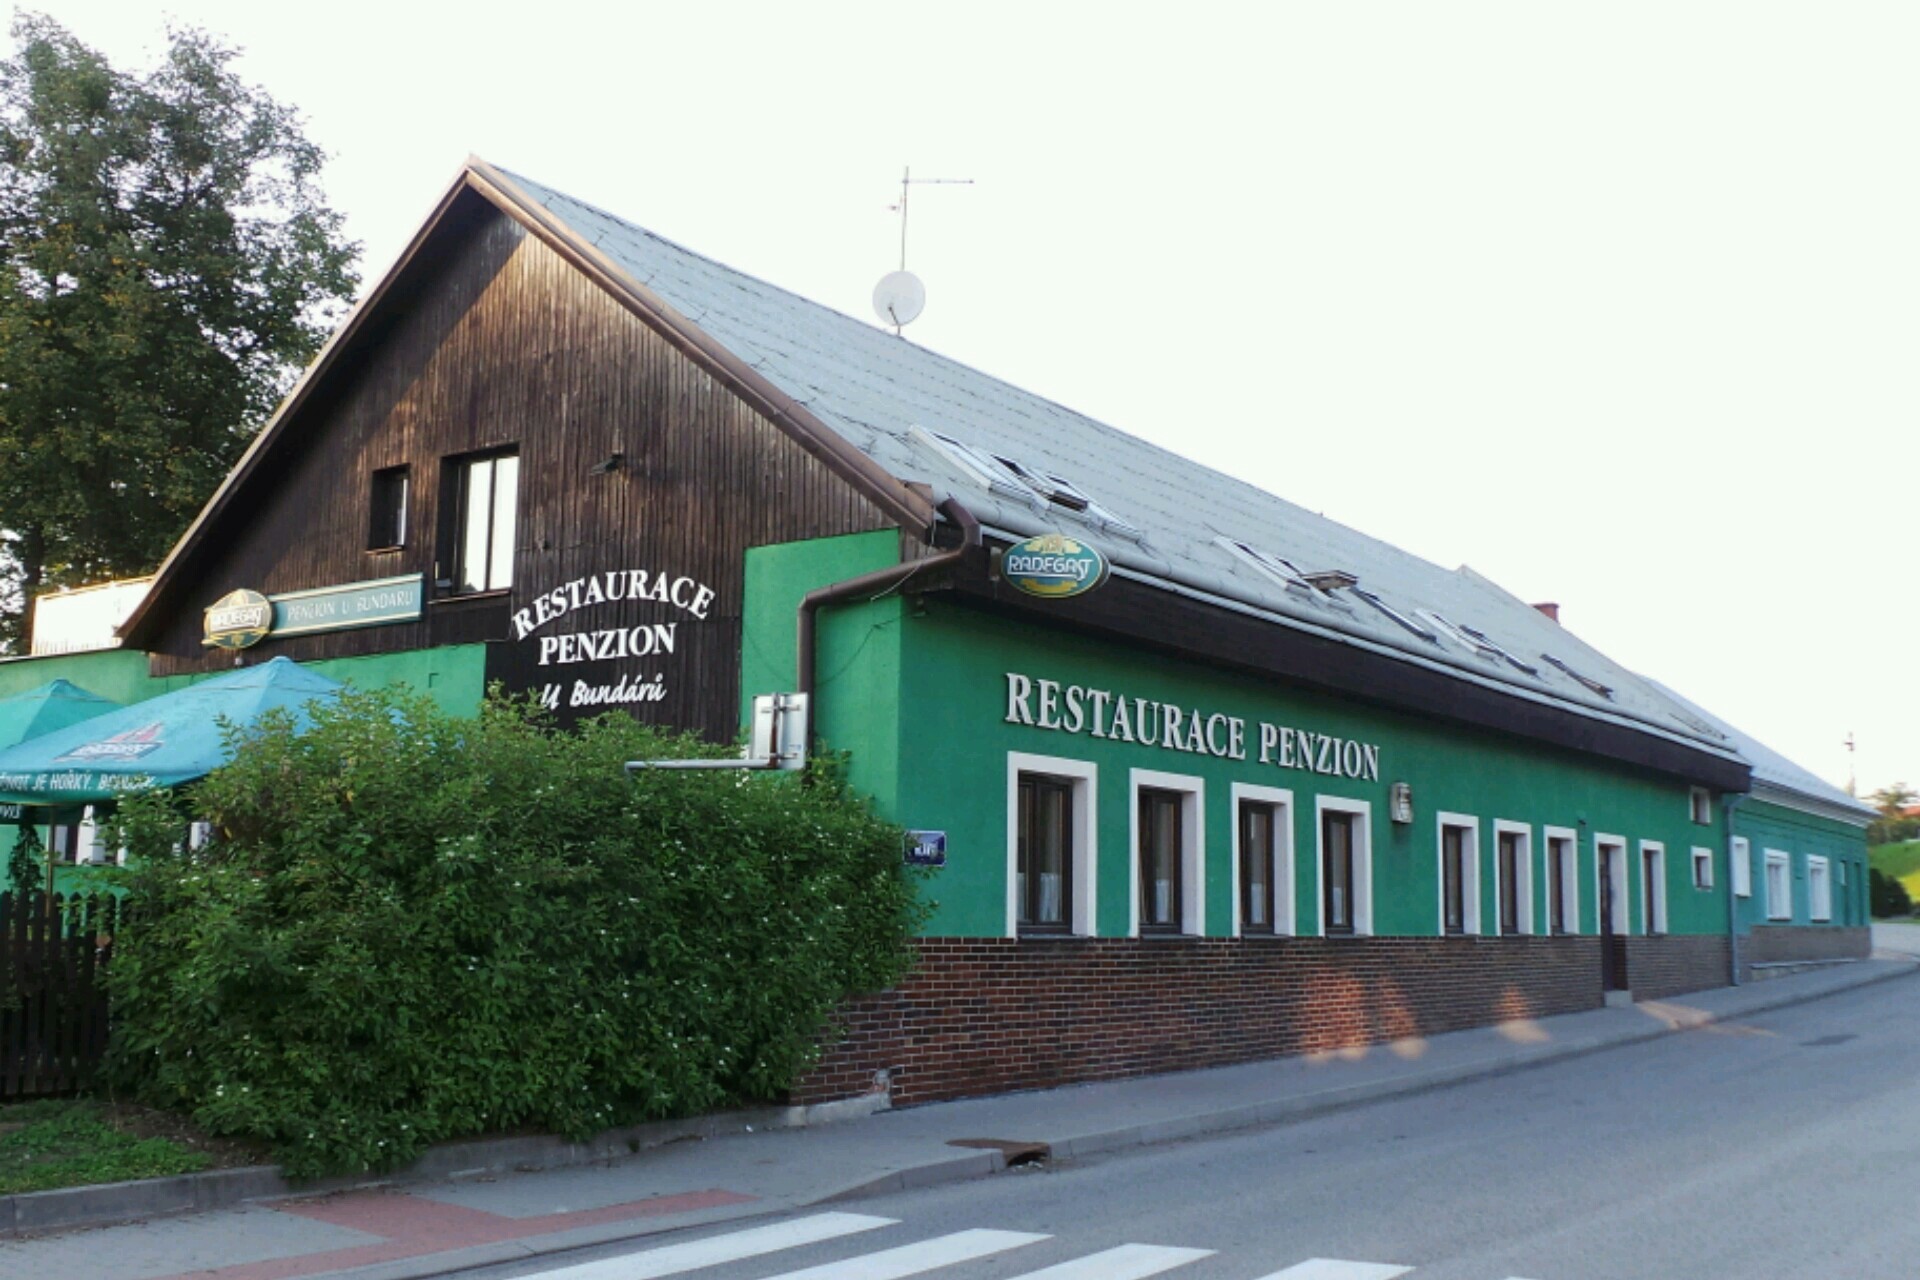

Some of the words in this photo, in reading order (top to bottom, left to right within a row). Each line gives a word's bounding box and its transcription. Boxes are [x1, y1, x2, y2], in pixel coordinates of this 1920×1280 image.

[1007, 555, 1094, 580] RADEGAST
[511, 569, 716, 641] RESTAURACE
[538, 622, 678, 666] PENZION
[540, 682, 561, 711] U
[569, 672, 667, 708] Bundárů
[1005, 672, 1247, 760] RESTAURACE
[1257, 721, 1381, 783] PENZION
[32, 773, 48, 791] JE
